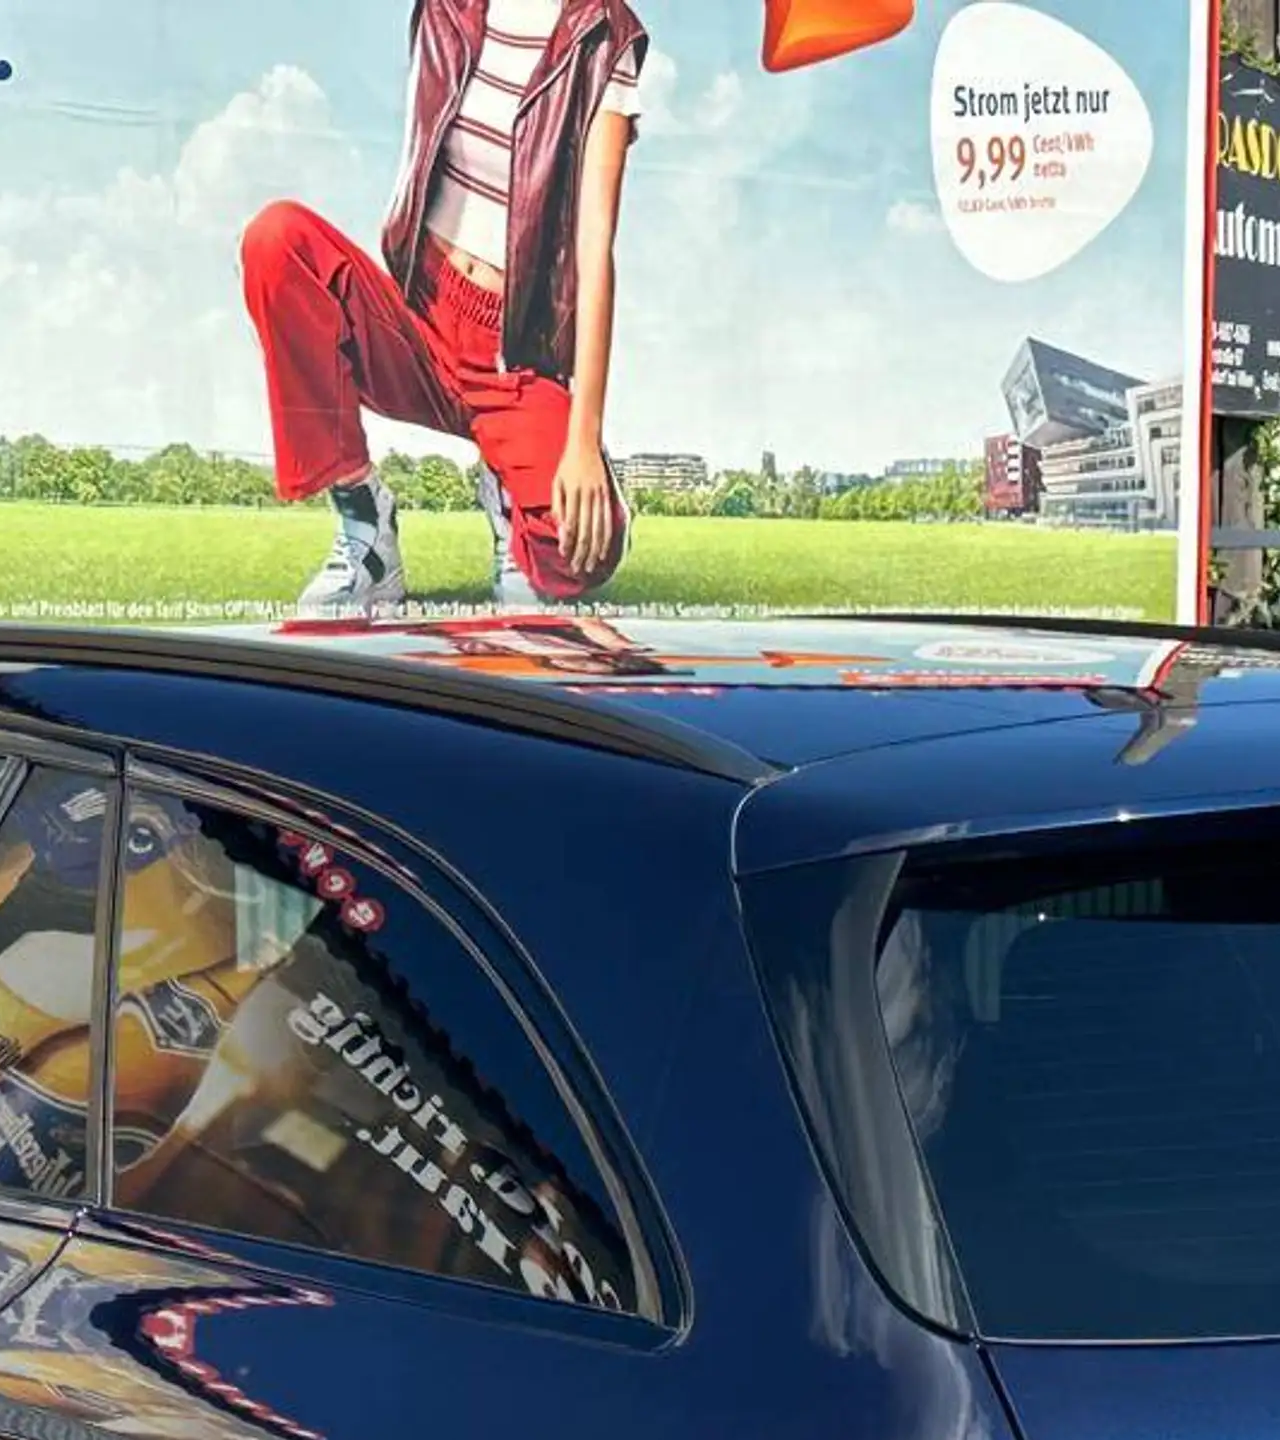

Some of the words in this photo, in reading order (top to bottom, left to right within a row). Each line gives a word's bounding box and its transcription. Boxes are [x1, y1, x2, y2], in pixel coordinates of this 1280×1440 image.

[953, 85, 1018, 117] Strom
[1023, 83, 1071, 123] jetzt
[1076, 90, 1110, 114] nur
[956, 135, 1027, 189] 9,99
